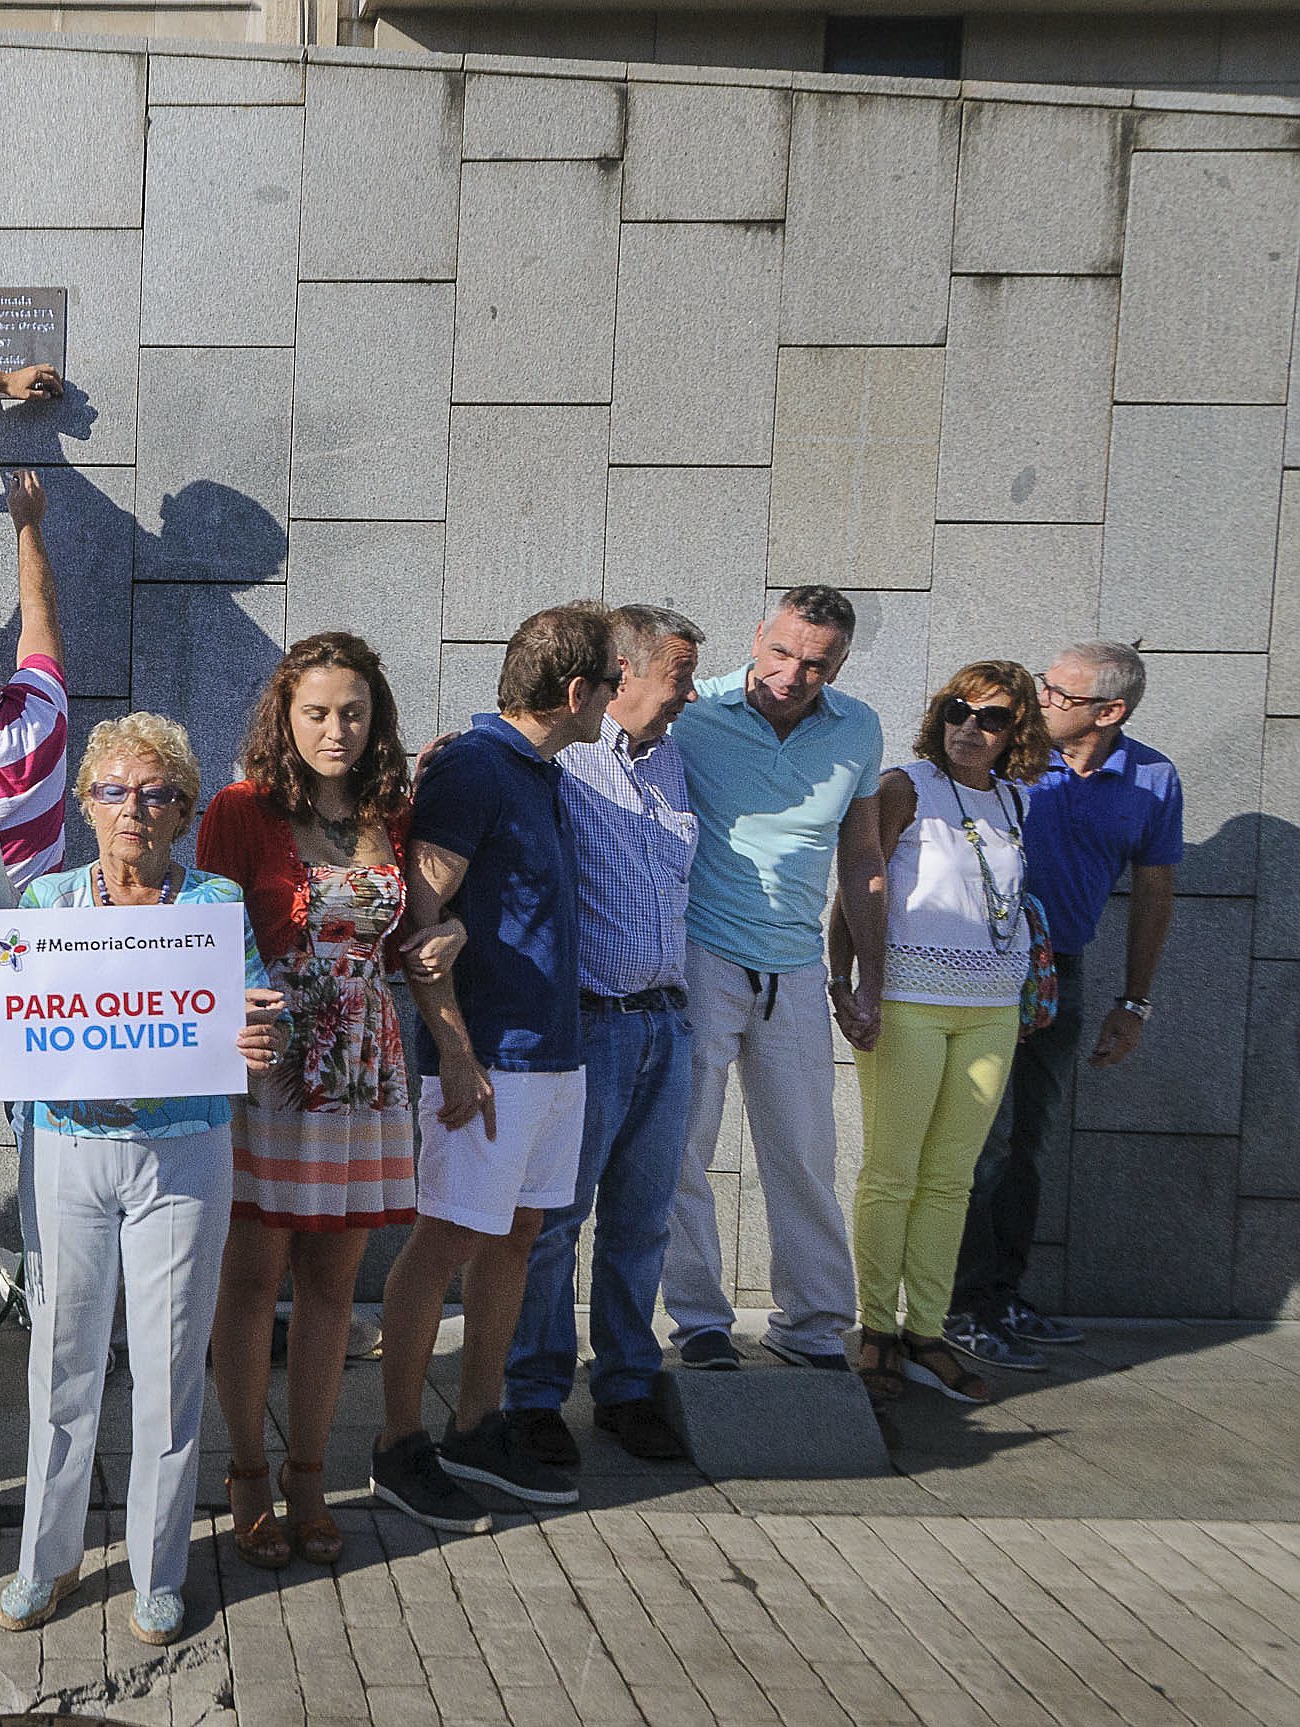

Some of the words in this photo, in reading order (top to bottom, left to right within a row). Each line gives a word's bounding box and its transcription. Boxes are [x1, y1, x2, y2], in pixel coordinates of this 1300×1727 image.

[33, 309, 54, 319] ETA
[18, 321, 55, 333] Ortega
[36, 934, 216, 953] #MemoriaContraETA
[6, 993, 89, 1020] PARA
[96, 990, 164, 1017] QUE
[170, 989, 216, 1015] YO
[26, 1026, 75, 1052] NO
[83, 1022, 198, 1050] OLVIDE
